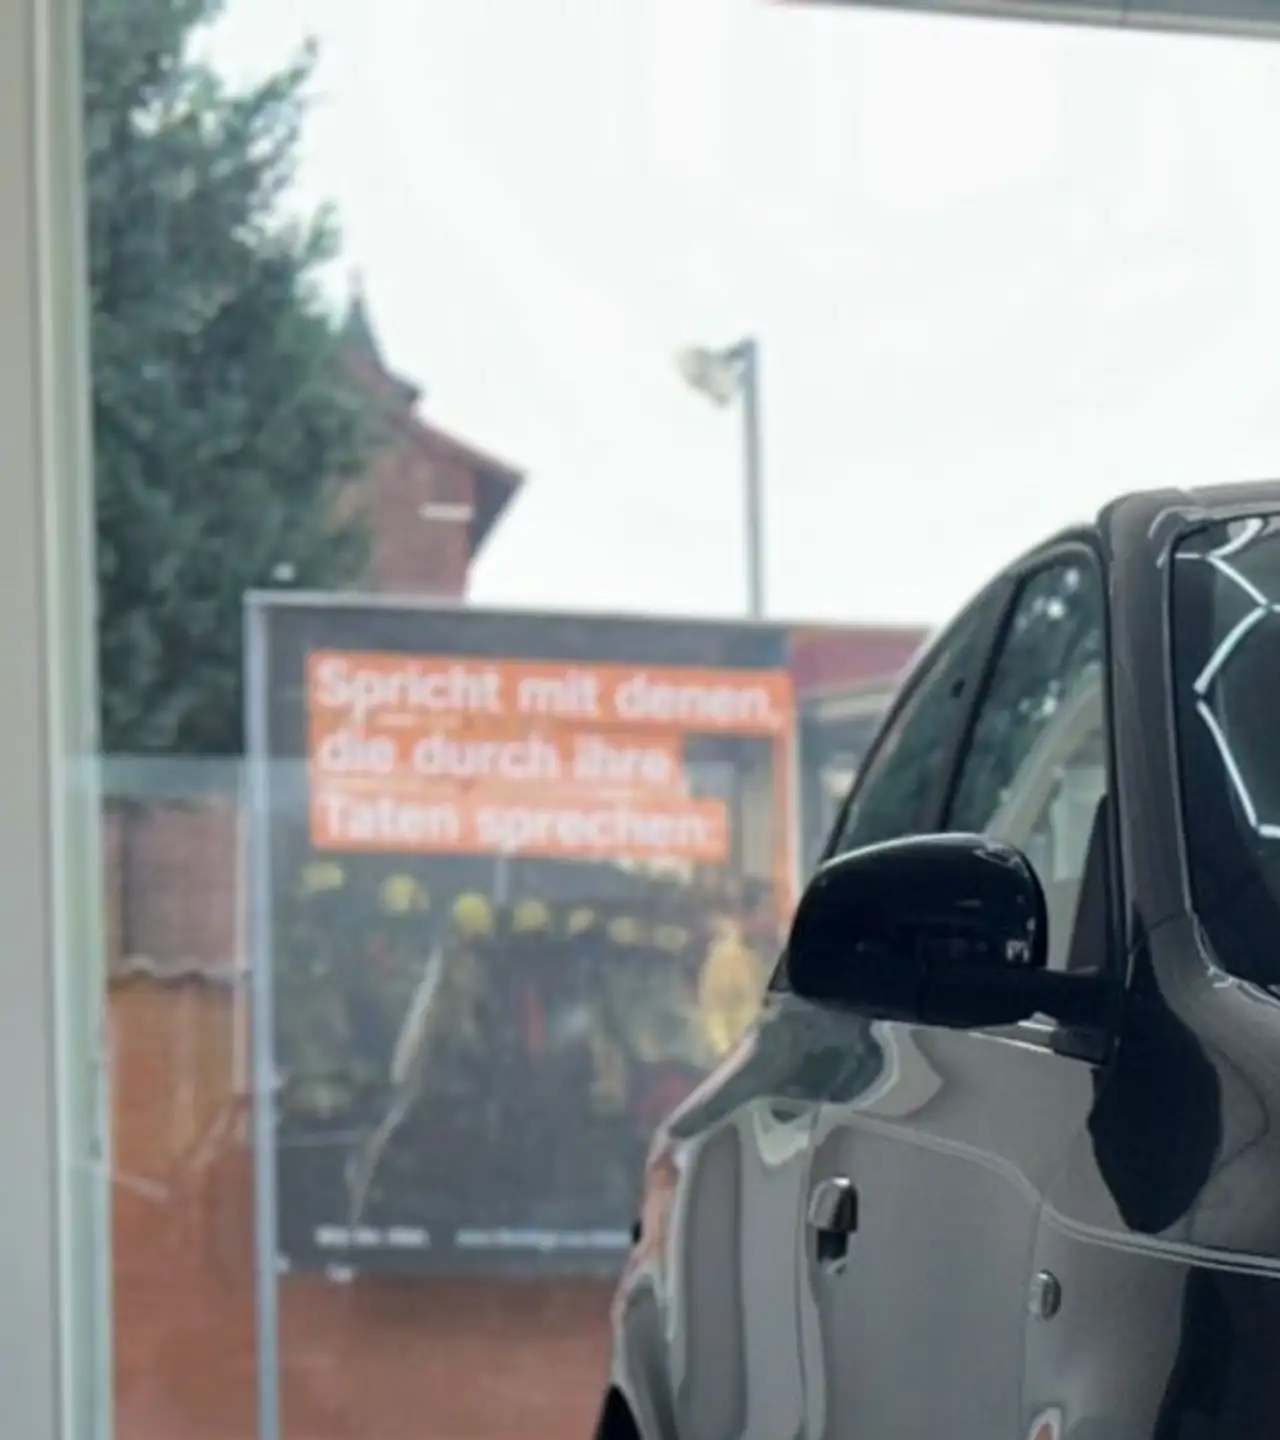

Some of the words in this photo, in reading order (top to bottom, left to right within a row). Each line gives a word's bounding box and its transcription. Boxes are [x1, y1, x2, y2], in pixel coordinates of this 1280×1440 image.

[316, 657, 500, 724] Spricht
[517, 667, 597, 715] mit
[318, 727, 396, 774] die
[412, 730, 557, 779] durch
[316, 792, 459, 841] Taten
